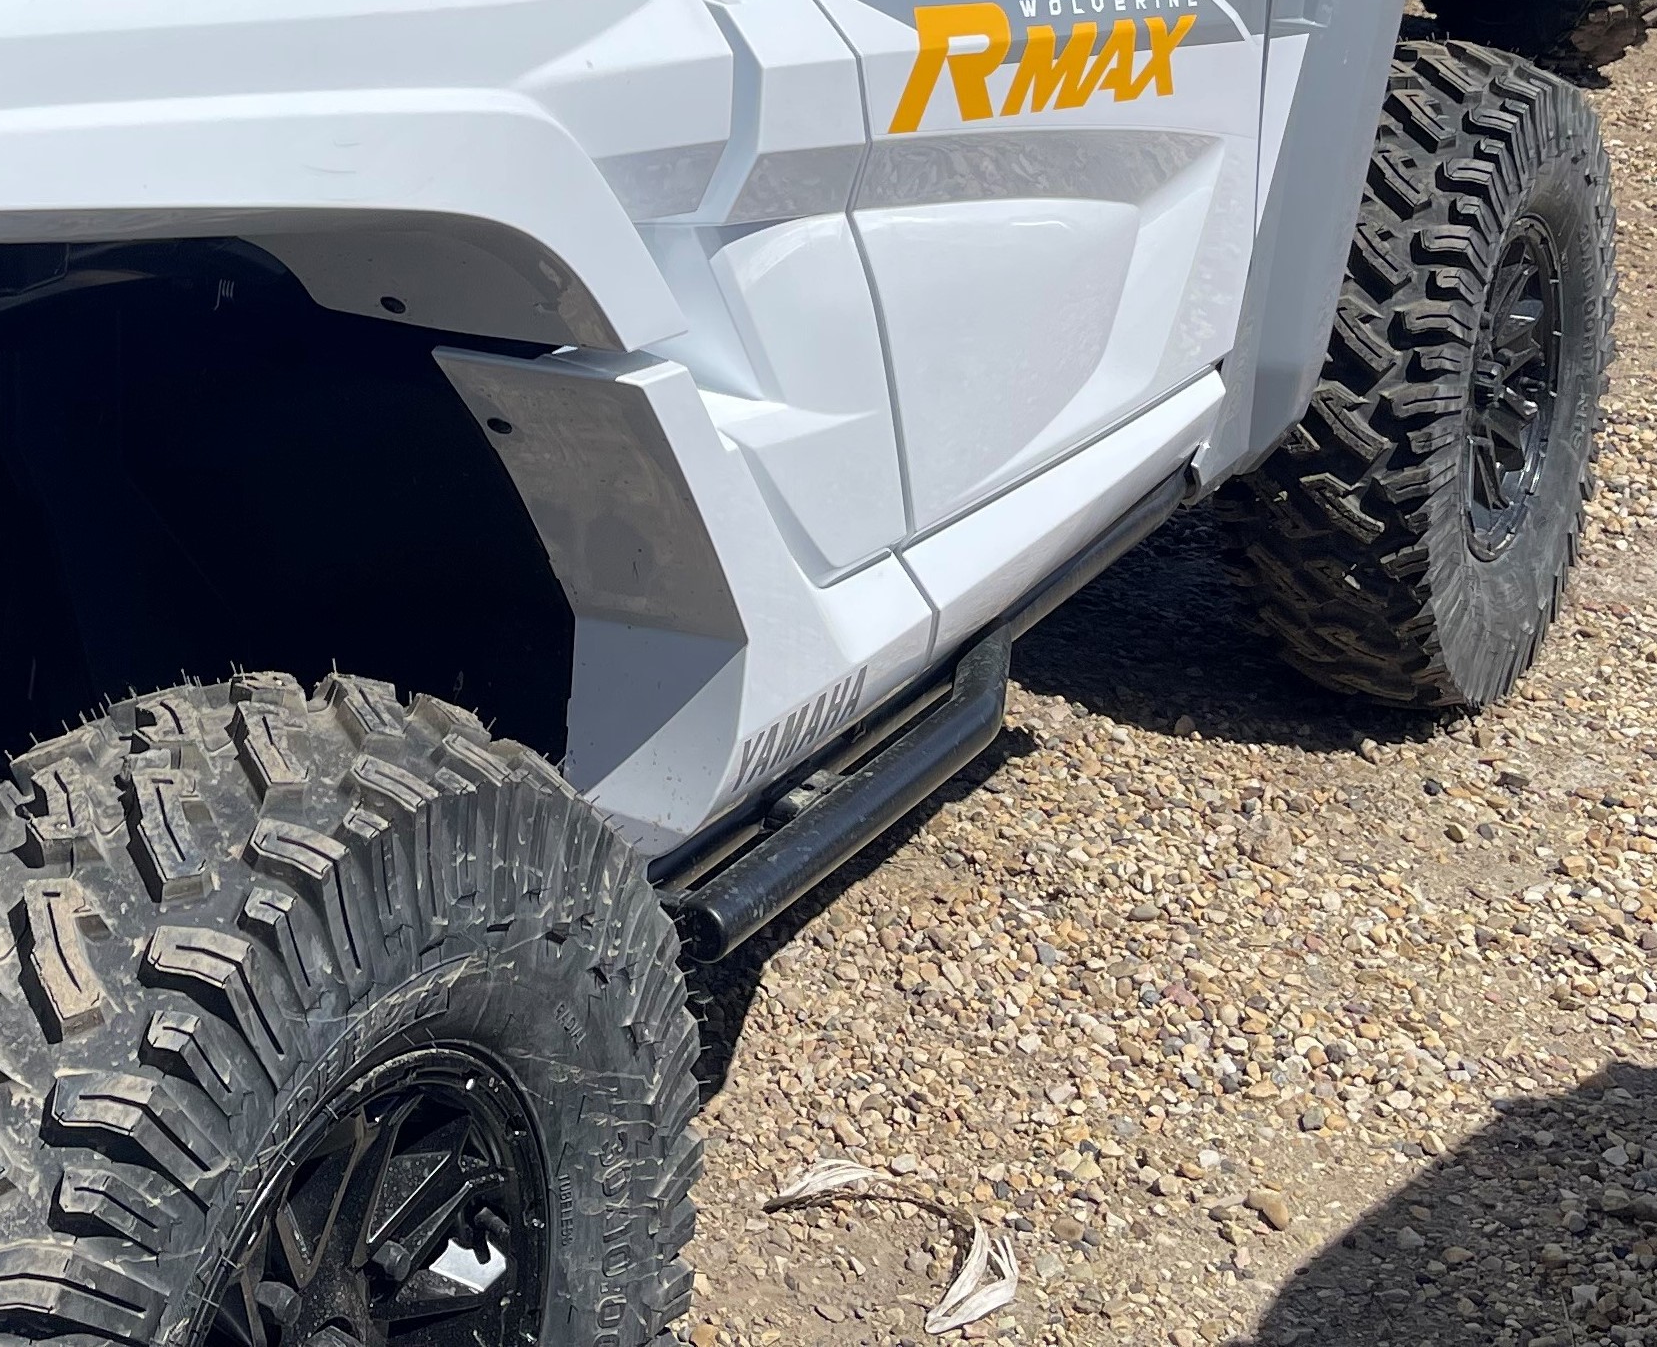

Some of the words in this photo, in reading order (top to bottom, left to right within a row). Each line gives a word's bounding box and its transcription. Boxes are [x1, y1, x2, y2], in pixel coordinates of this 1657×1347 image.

[887, 1, 1198, 135] RMAX
[731, 663, 869, 793] YAMAHA
[556, 1173, 575, 1247] TUBELESS
